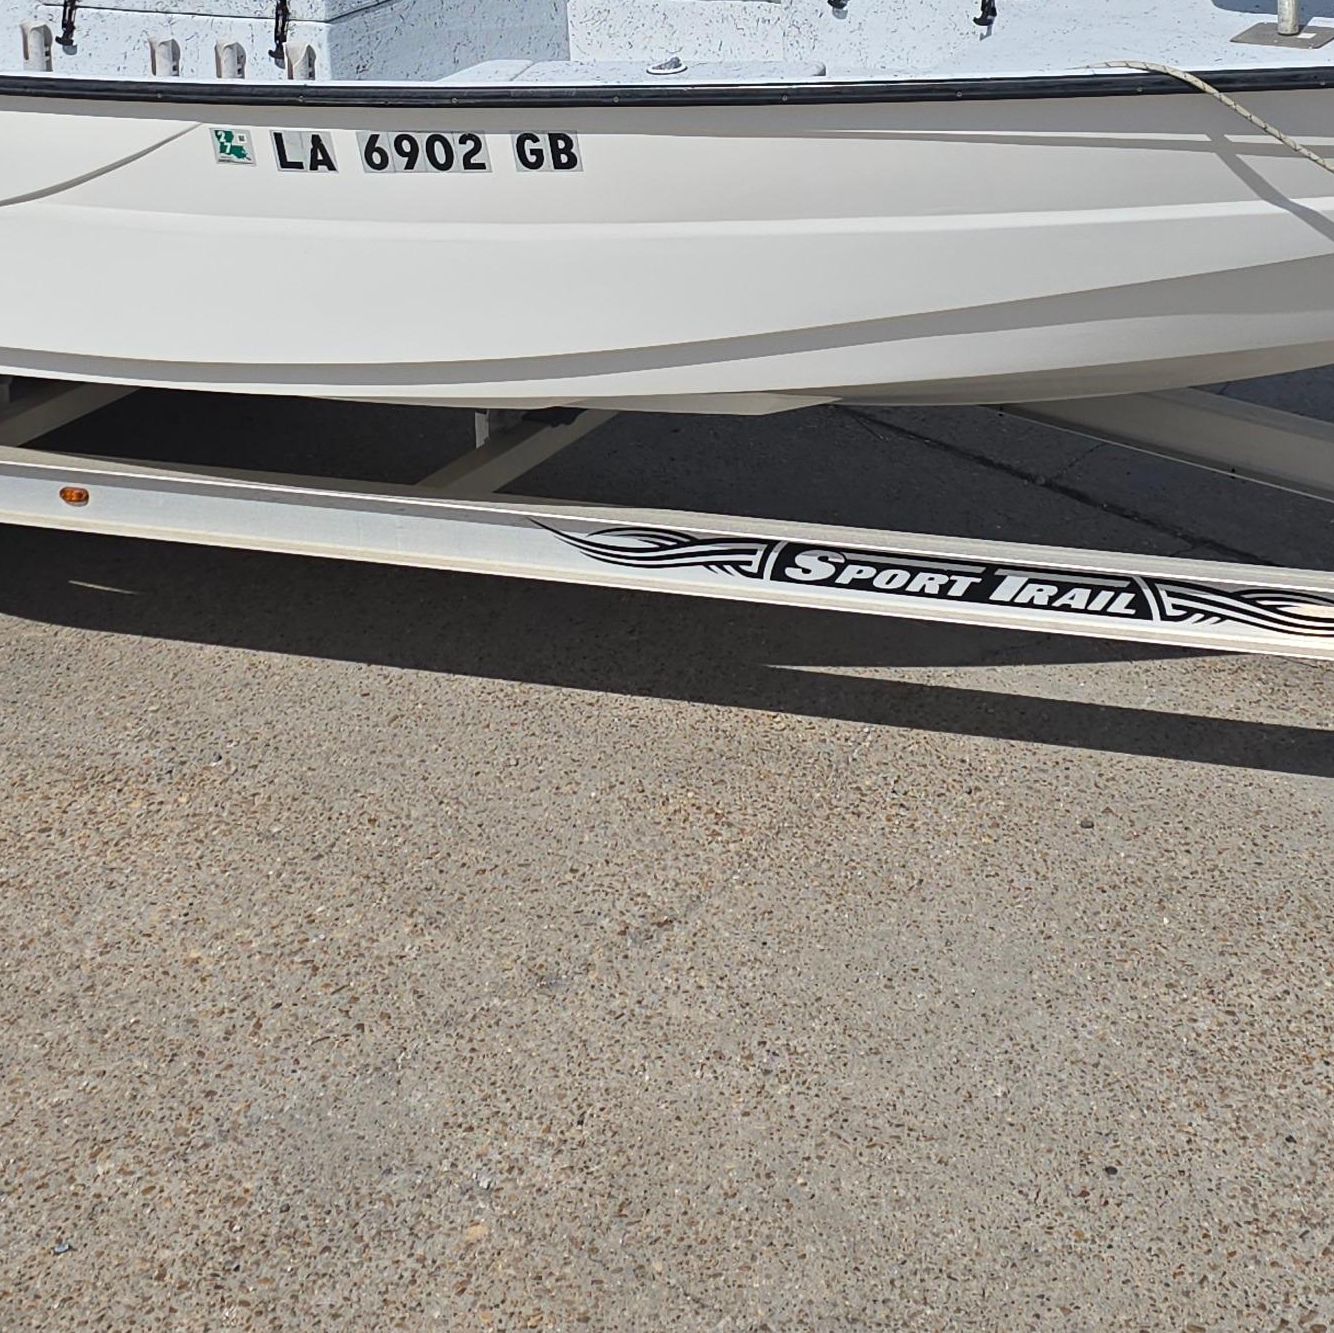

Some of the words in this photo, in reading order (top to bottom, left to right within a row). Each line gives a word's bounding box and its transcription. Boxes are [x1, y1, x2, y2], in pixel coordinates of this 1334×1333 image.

[273, 132, 338, 172] LA
[366, 133, 487, 171] 6902
[516, 132, 578, 171] GB
[784, 549, 984, 597] SPORT
[989, 568, 1138, 615] TRAIL
